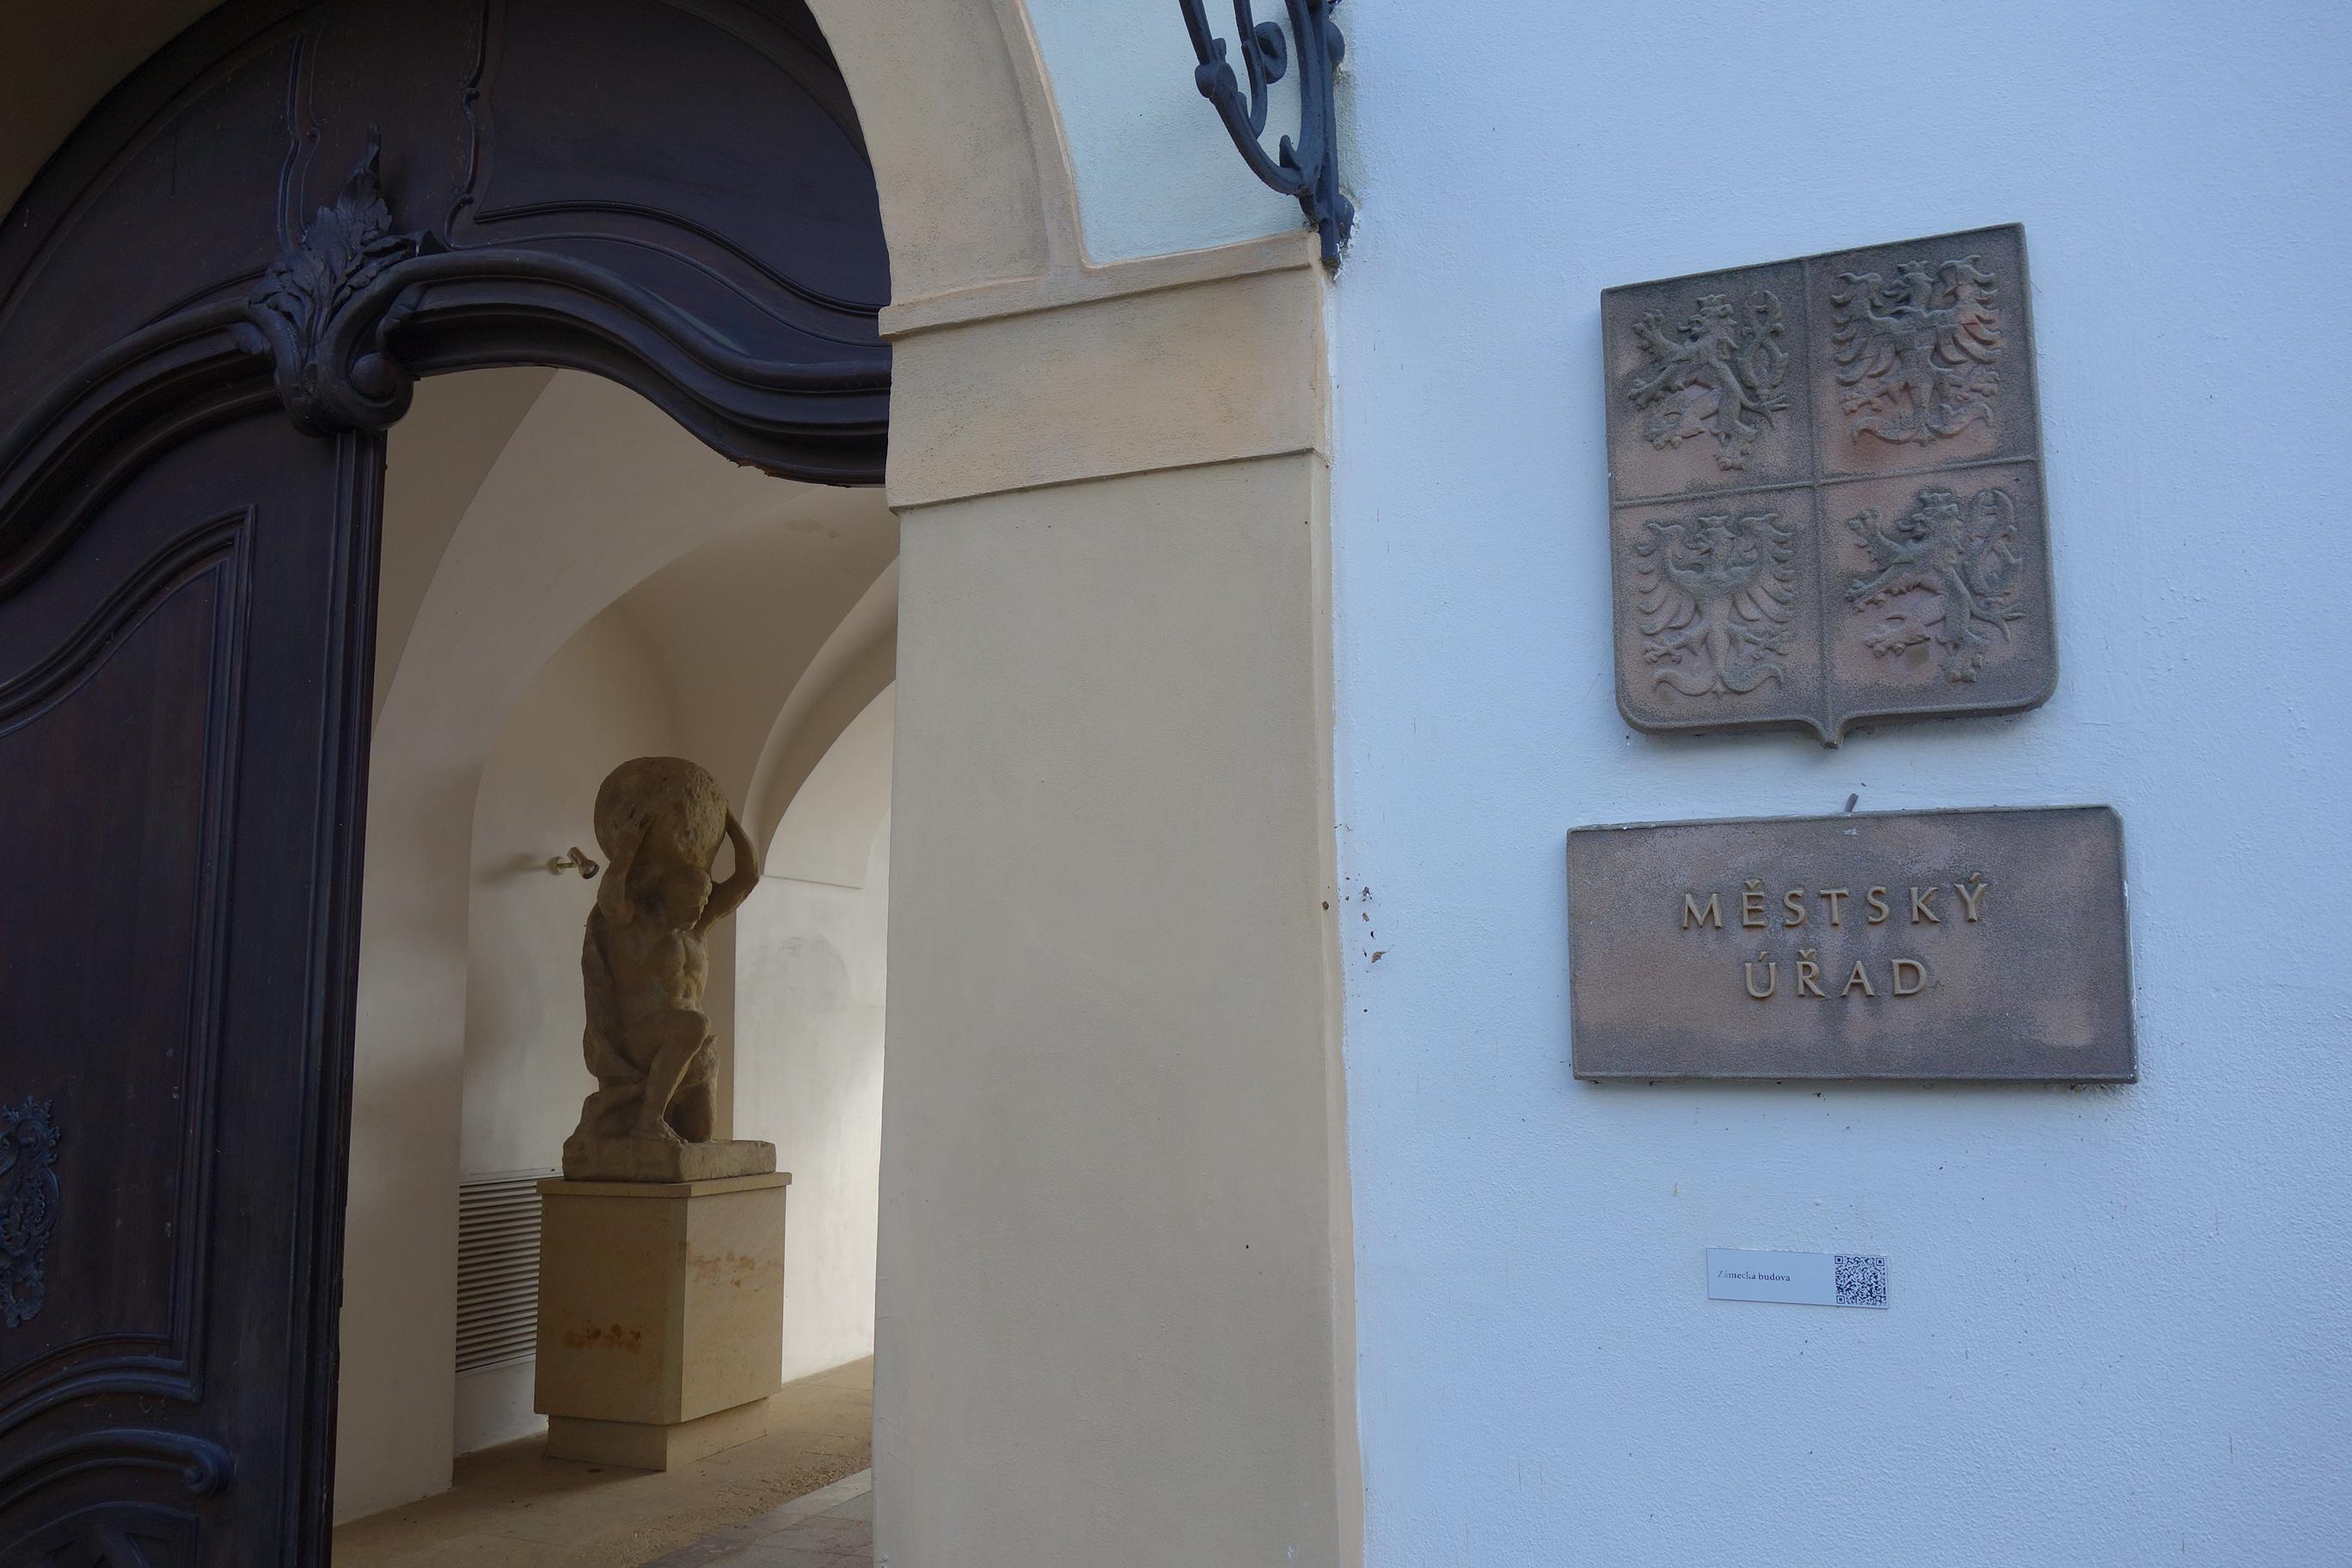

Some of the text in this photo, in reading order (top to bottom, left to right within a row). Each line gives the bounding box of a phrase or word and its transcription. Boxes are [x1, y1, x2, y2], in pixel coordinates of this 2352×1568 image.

[1681, 871, 1988, 930] MĚSTSKÝ
[1744, 949, 1928, 999] ÚŘAD
[1758, 1271, 1791, 1282] budova
